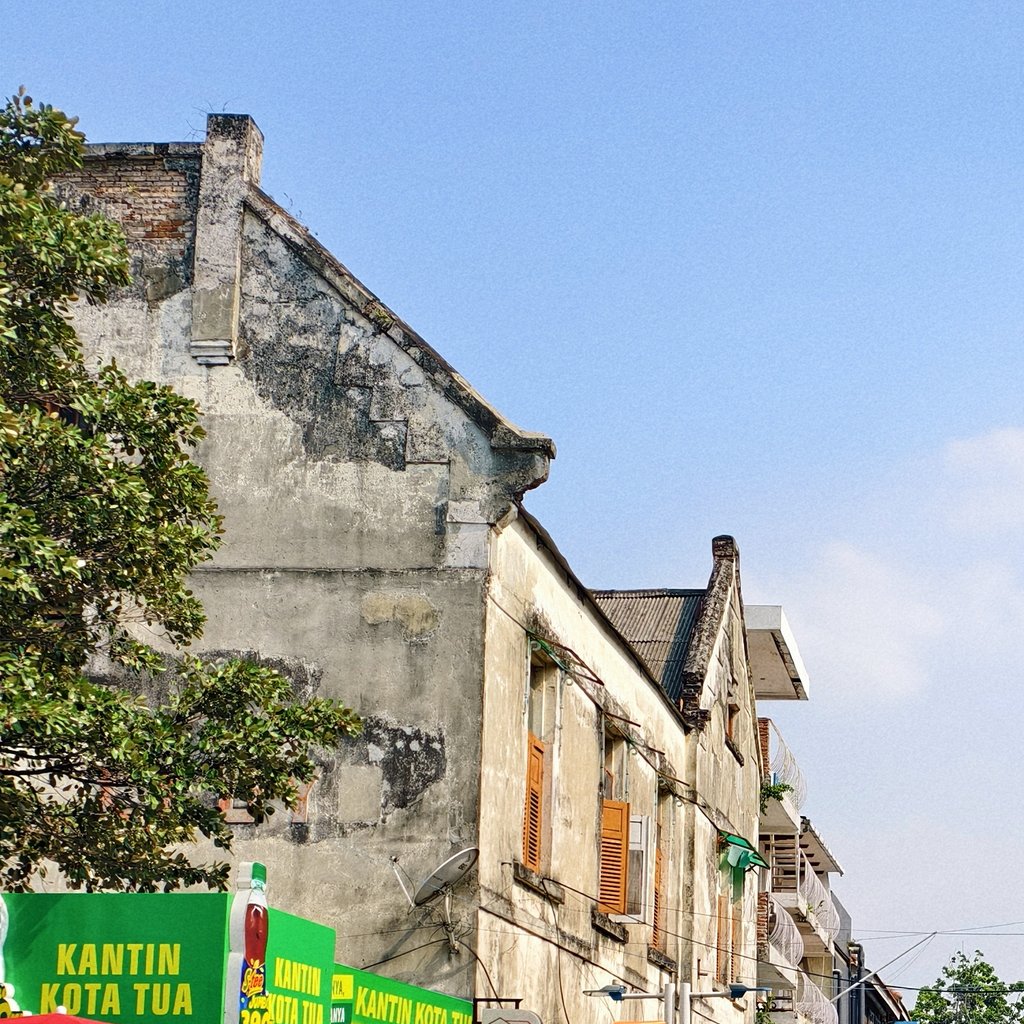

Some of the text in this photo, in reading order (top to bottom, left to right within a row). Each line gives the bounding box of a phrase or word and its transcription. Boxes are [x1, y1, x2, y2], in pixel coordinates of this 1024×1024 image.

[56, 943, 181, 976] KANTIN
[275, 957, 321, 997] KANTIN
[40, 983, 121, 1015] KOTA
[133, 983, 193, 1016] TUA
